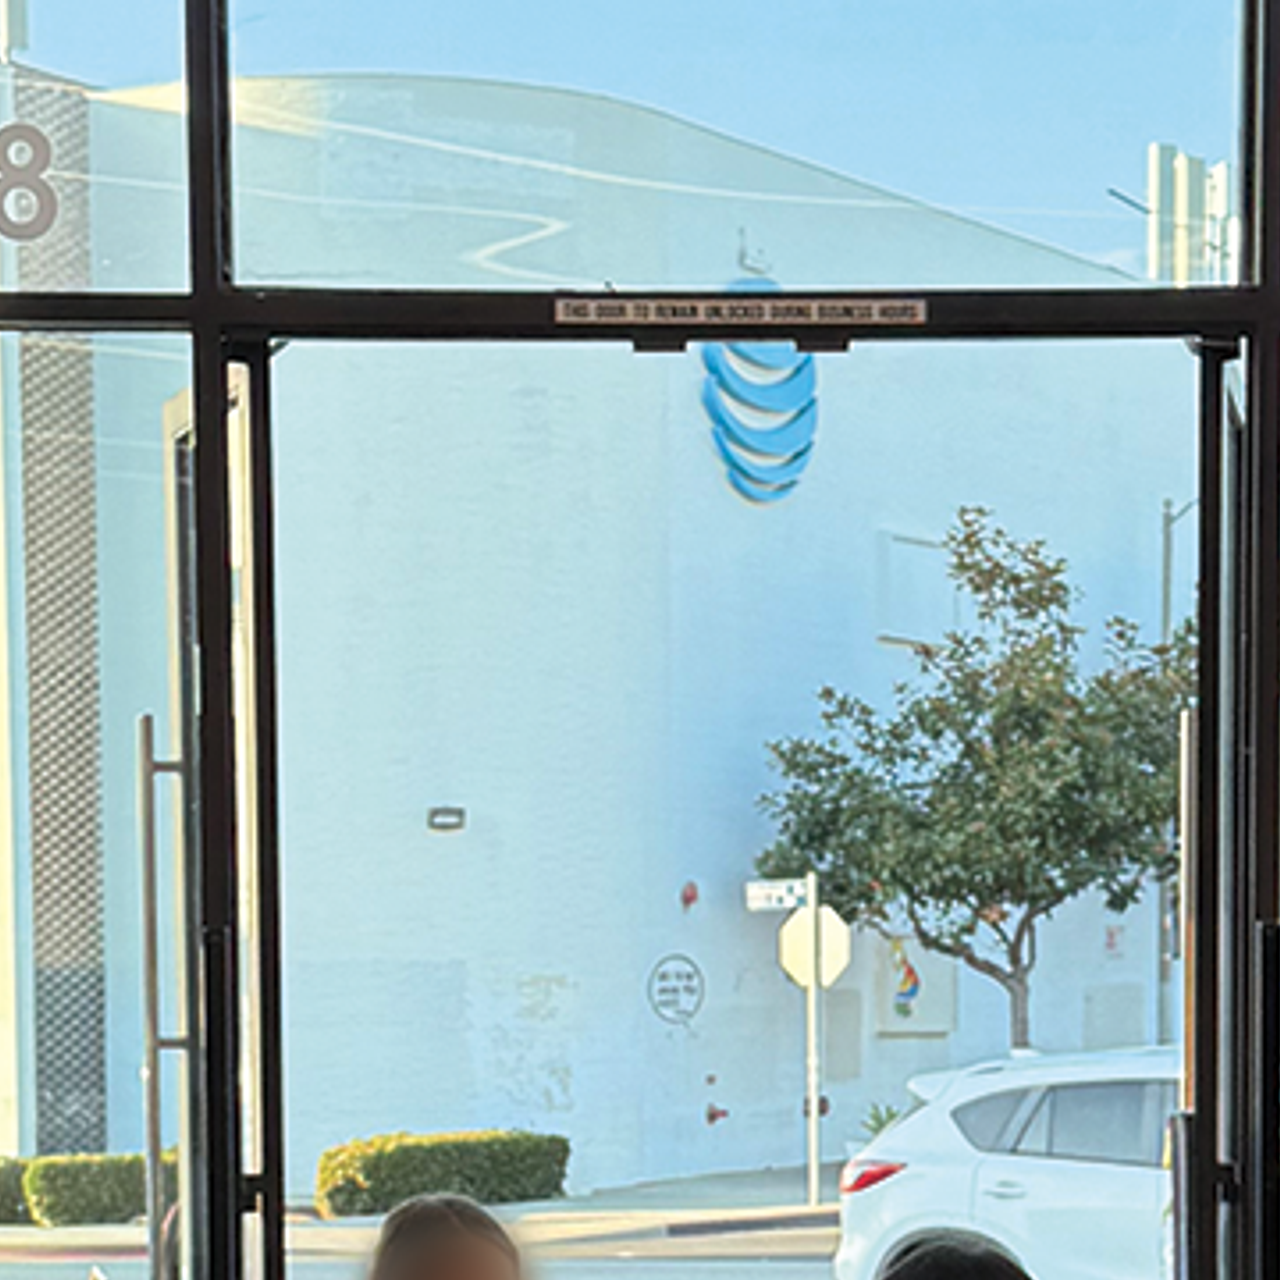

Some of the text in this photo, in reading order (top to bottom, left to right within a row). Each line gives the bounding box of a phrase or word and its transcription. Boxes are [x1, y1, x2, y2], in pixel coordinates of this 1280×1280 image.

[596, 304, 626, 319] DOOR
[633, 304, 648, 319] TO
[705, 304, 764, 319] UNLOCKED
